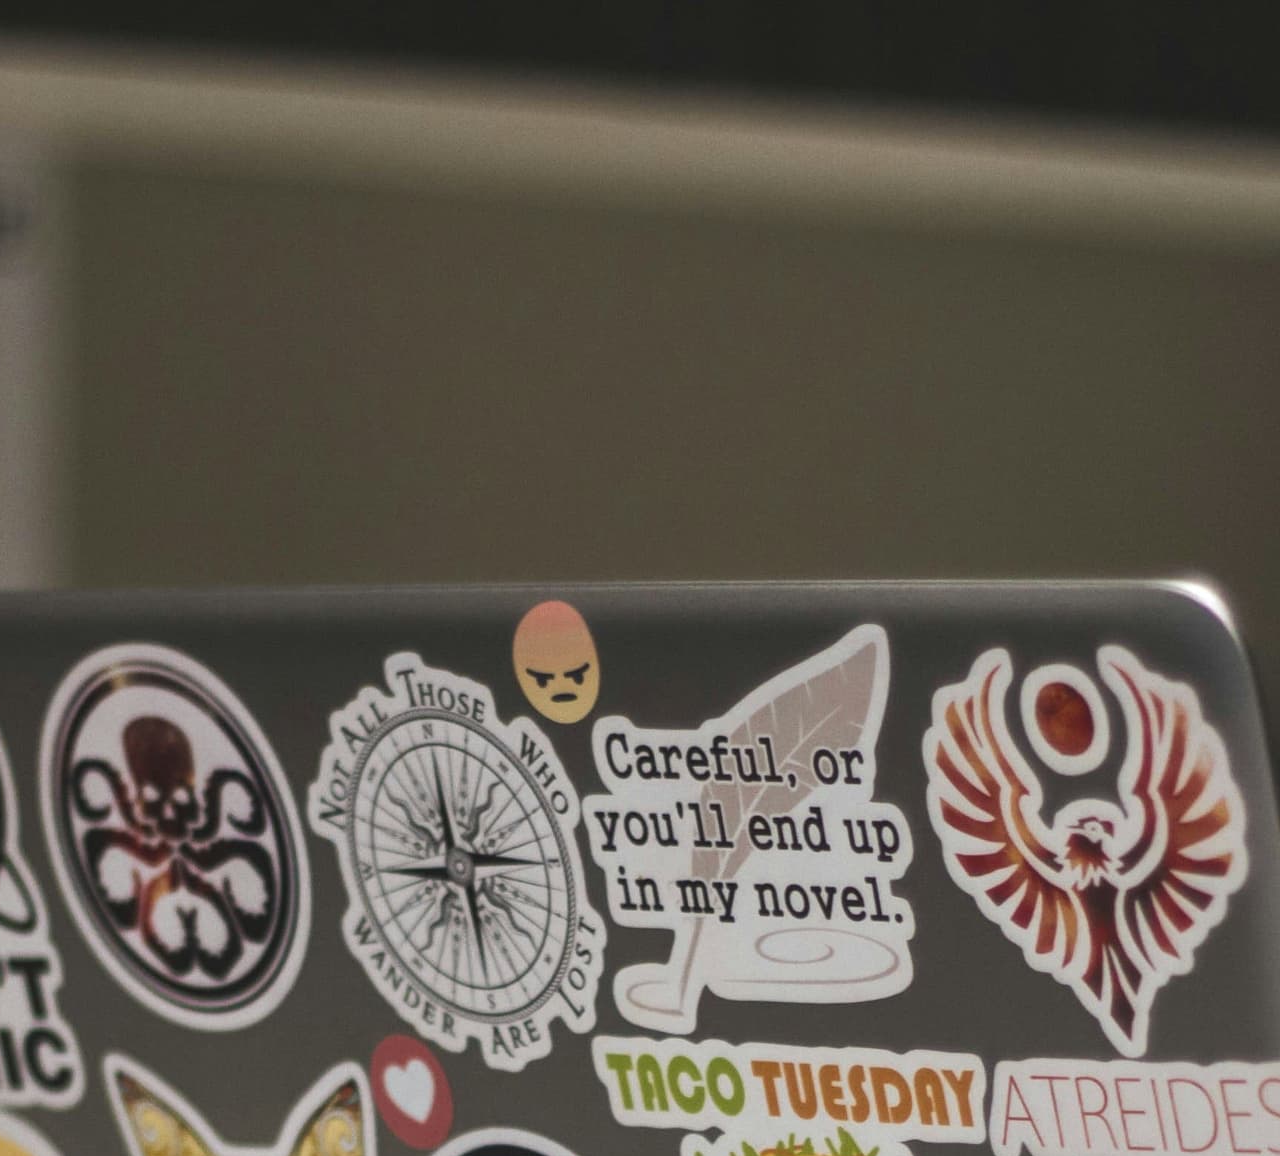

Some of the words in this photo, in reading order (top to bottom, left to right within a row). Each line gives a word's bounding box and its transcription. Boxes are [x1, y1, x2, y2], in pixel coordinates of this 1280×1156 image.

[319, 760, 352, 831] NOT
[341, 702, 388, 754] ALL
[396, 669, 486, 724] THOSE
[520, 734, 569, 817] WHO
[604, 732, 798, 788] Careful,
[812, 746, 865, 786] or
[595, 801, 734, 853] you'll
[748, 805, 830, 853] end
[844, 820, 903, 863] up
[616, 866, 664, 913] in
[677, 877, 738, 923] my
[753, 875, 906, 925] novel.
[354, 916, 456, 1038] WANDER
[491, 1018, 541, 1059] ARE
[556, 916, 596, 1019] LOST
[605, 1052, 746, 1116] TACO
[750, 1058, 975, 1128] TUESDAY
